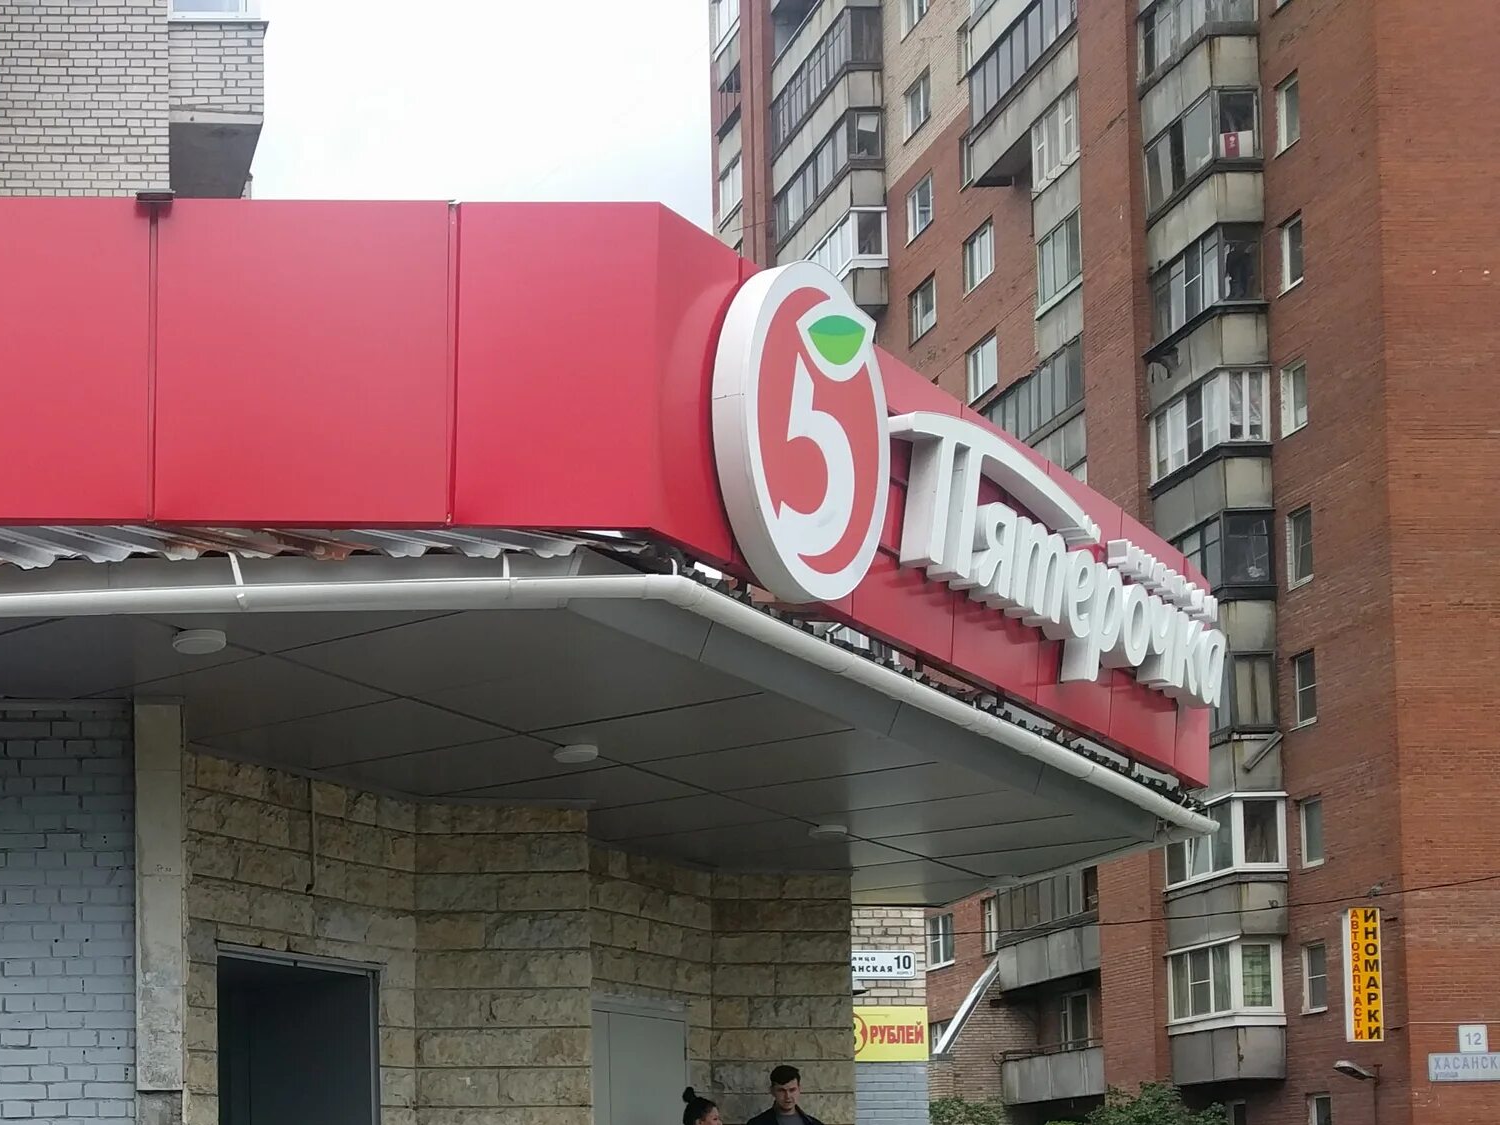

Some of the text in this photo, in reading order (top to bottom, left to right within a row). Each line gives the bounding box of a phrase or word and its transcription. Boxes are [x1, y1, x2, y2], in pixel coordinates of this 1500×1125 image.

[894, 955, 911, 969] 10
[1351, 909, 1363, 1040] АВТОЗАПЧАСТИ
[1363, 909, 1382, 1040] ИНОМАРКИ
[869, 1021, 924, 1044] РУБЛЕЙ
[1465, 1032, 1482, 1046] 12
